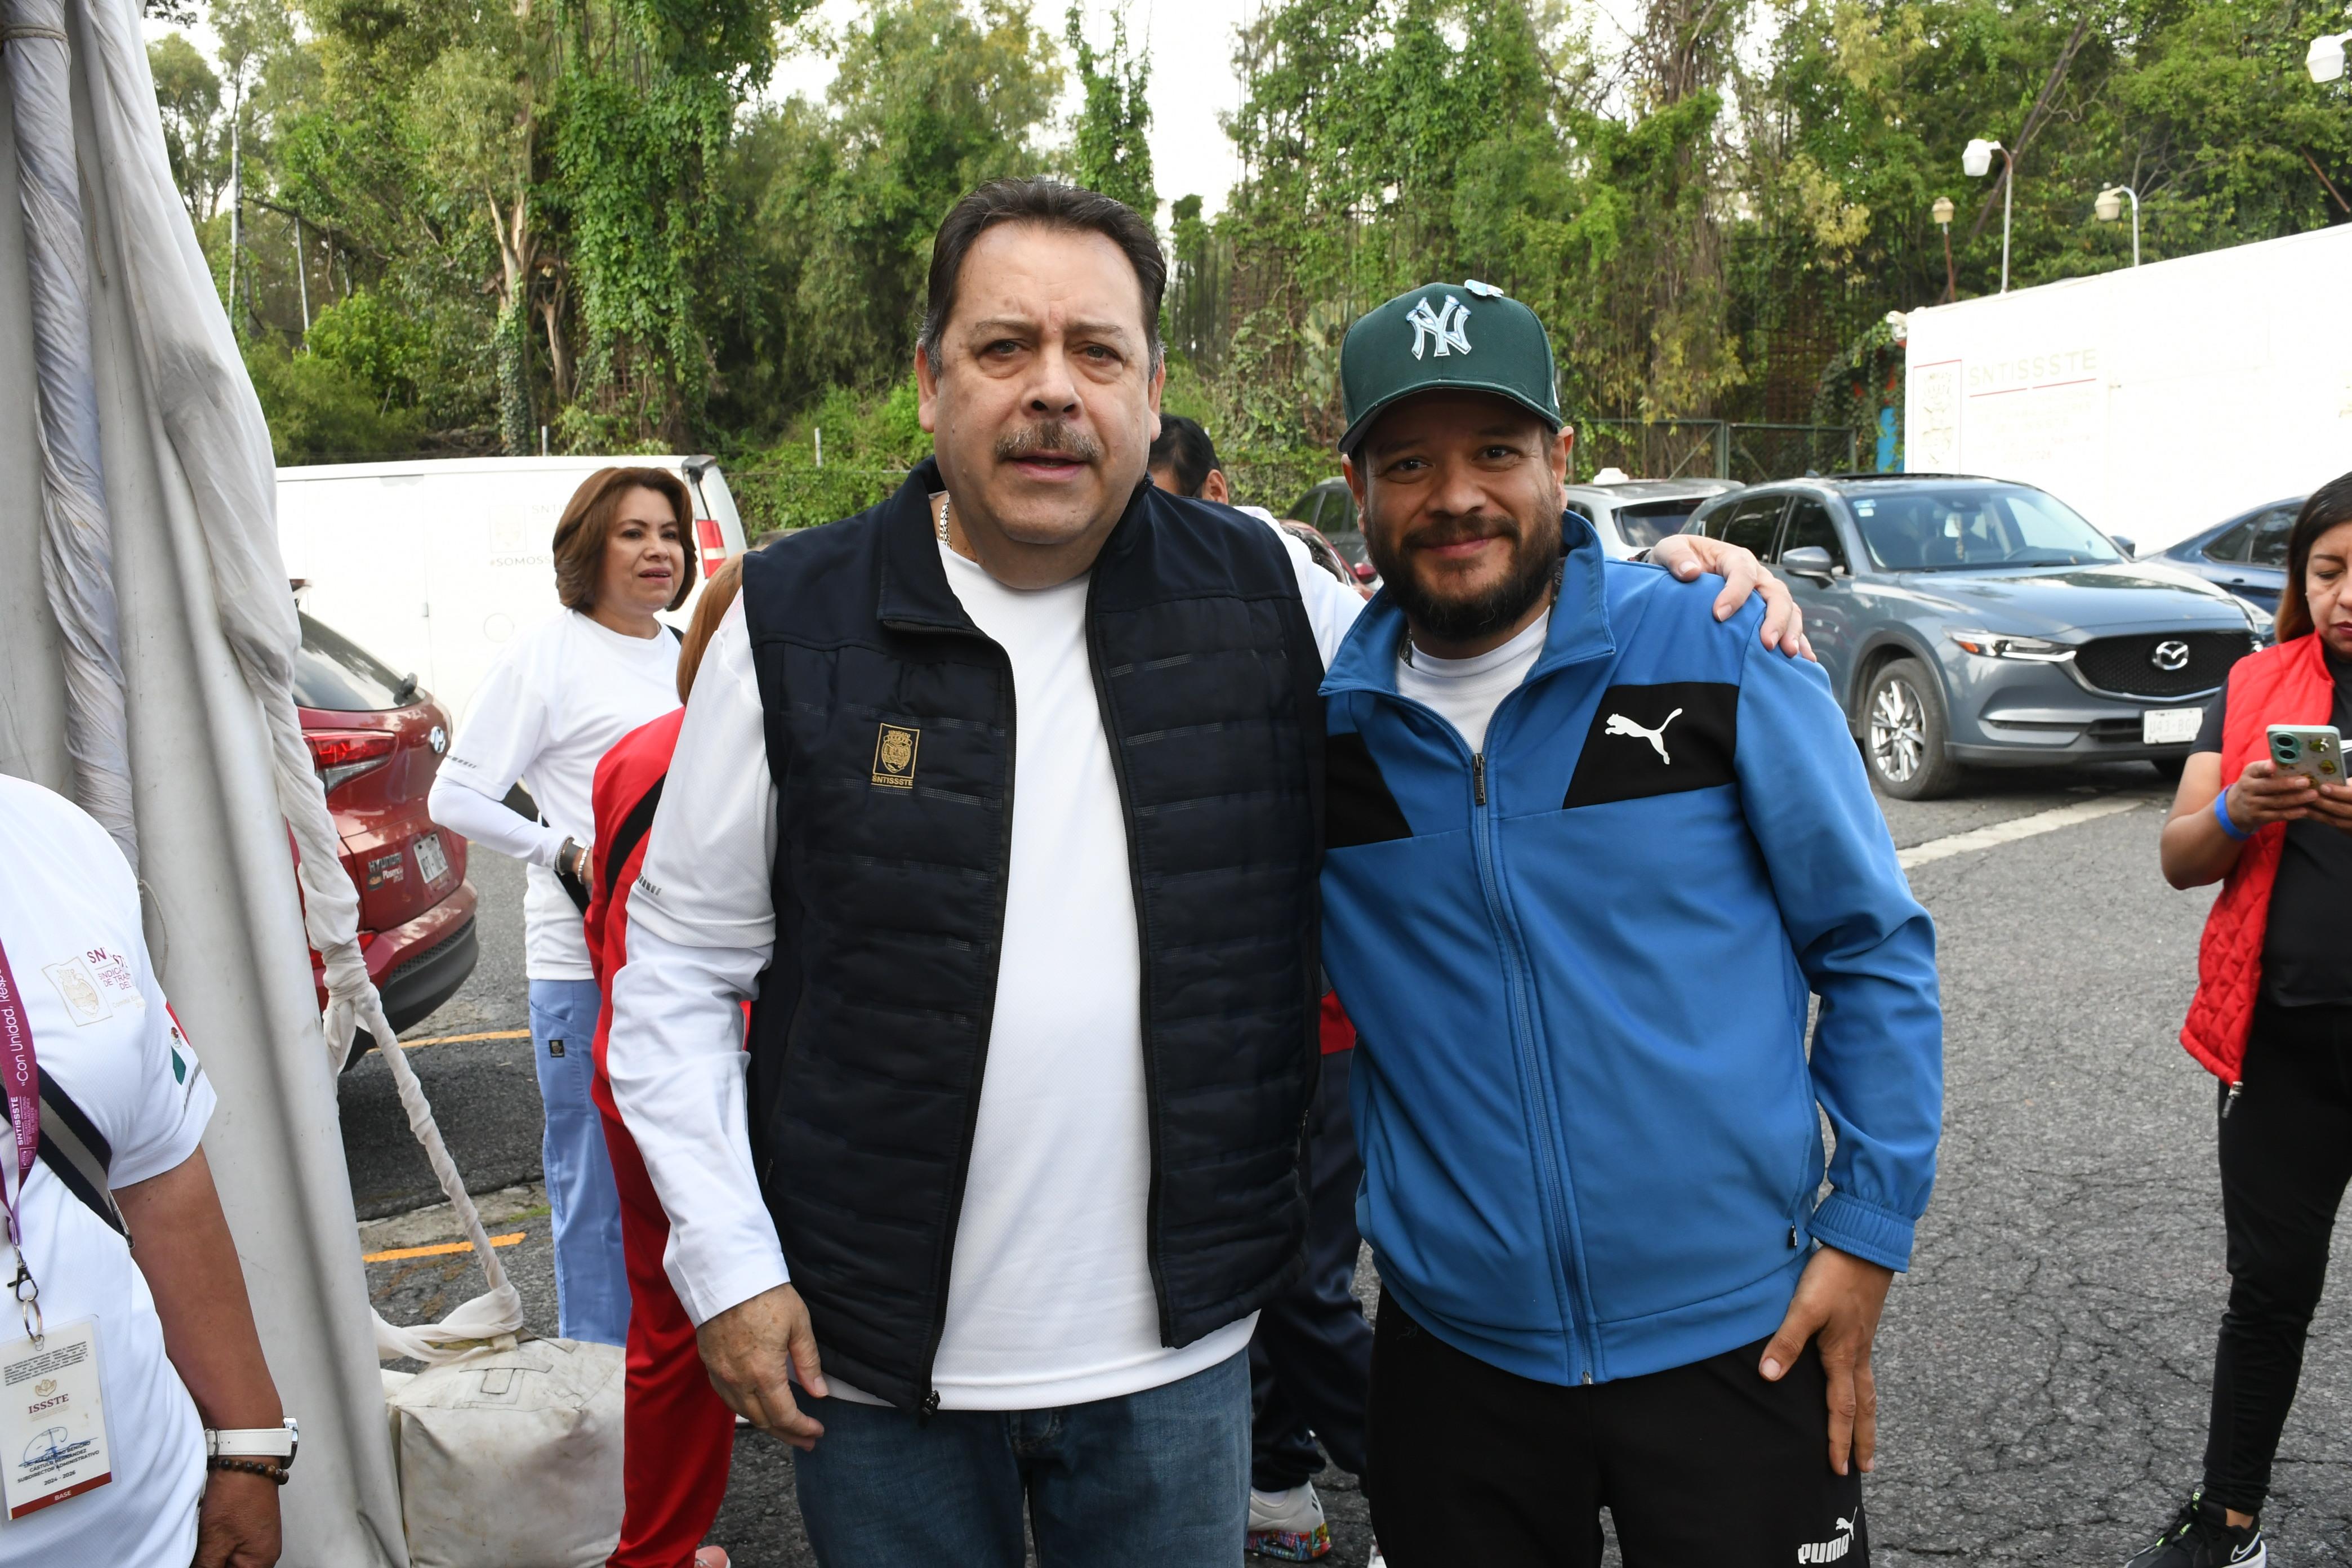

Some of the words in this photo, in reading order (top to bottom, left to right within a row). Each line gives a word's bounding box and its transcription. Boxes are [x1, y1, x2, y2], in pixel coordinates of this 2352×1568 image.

[1969, 348, 2097, 387] SNTISSSTE
[872, 776, 913, 786] SNTISSSTE
[4, 1005, 23, 1052] Unidad,
[11, 1096, 24, 1146] SNTISSSTE
[29, 1393, 69, 1414] ISSSTE
[17, 1466, 55, 1483] SUBDIRECTOR
[56, 1450, 100, 1469] ADMINISTRATIVO
[44, 1477, 58, 1486] 2024
[63, 1470, 76, 1478] 2026
[54, 1490, 72, 1501] BASE
[1798, 1533, 1849, 1564] PUMA
